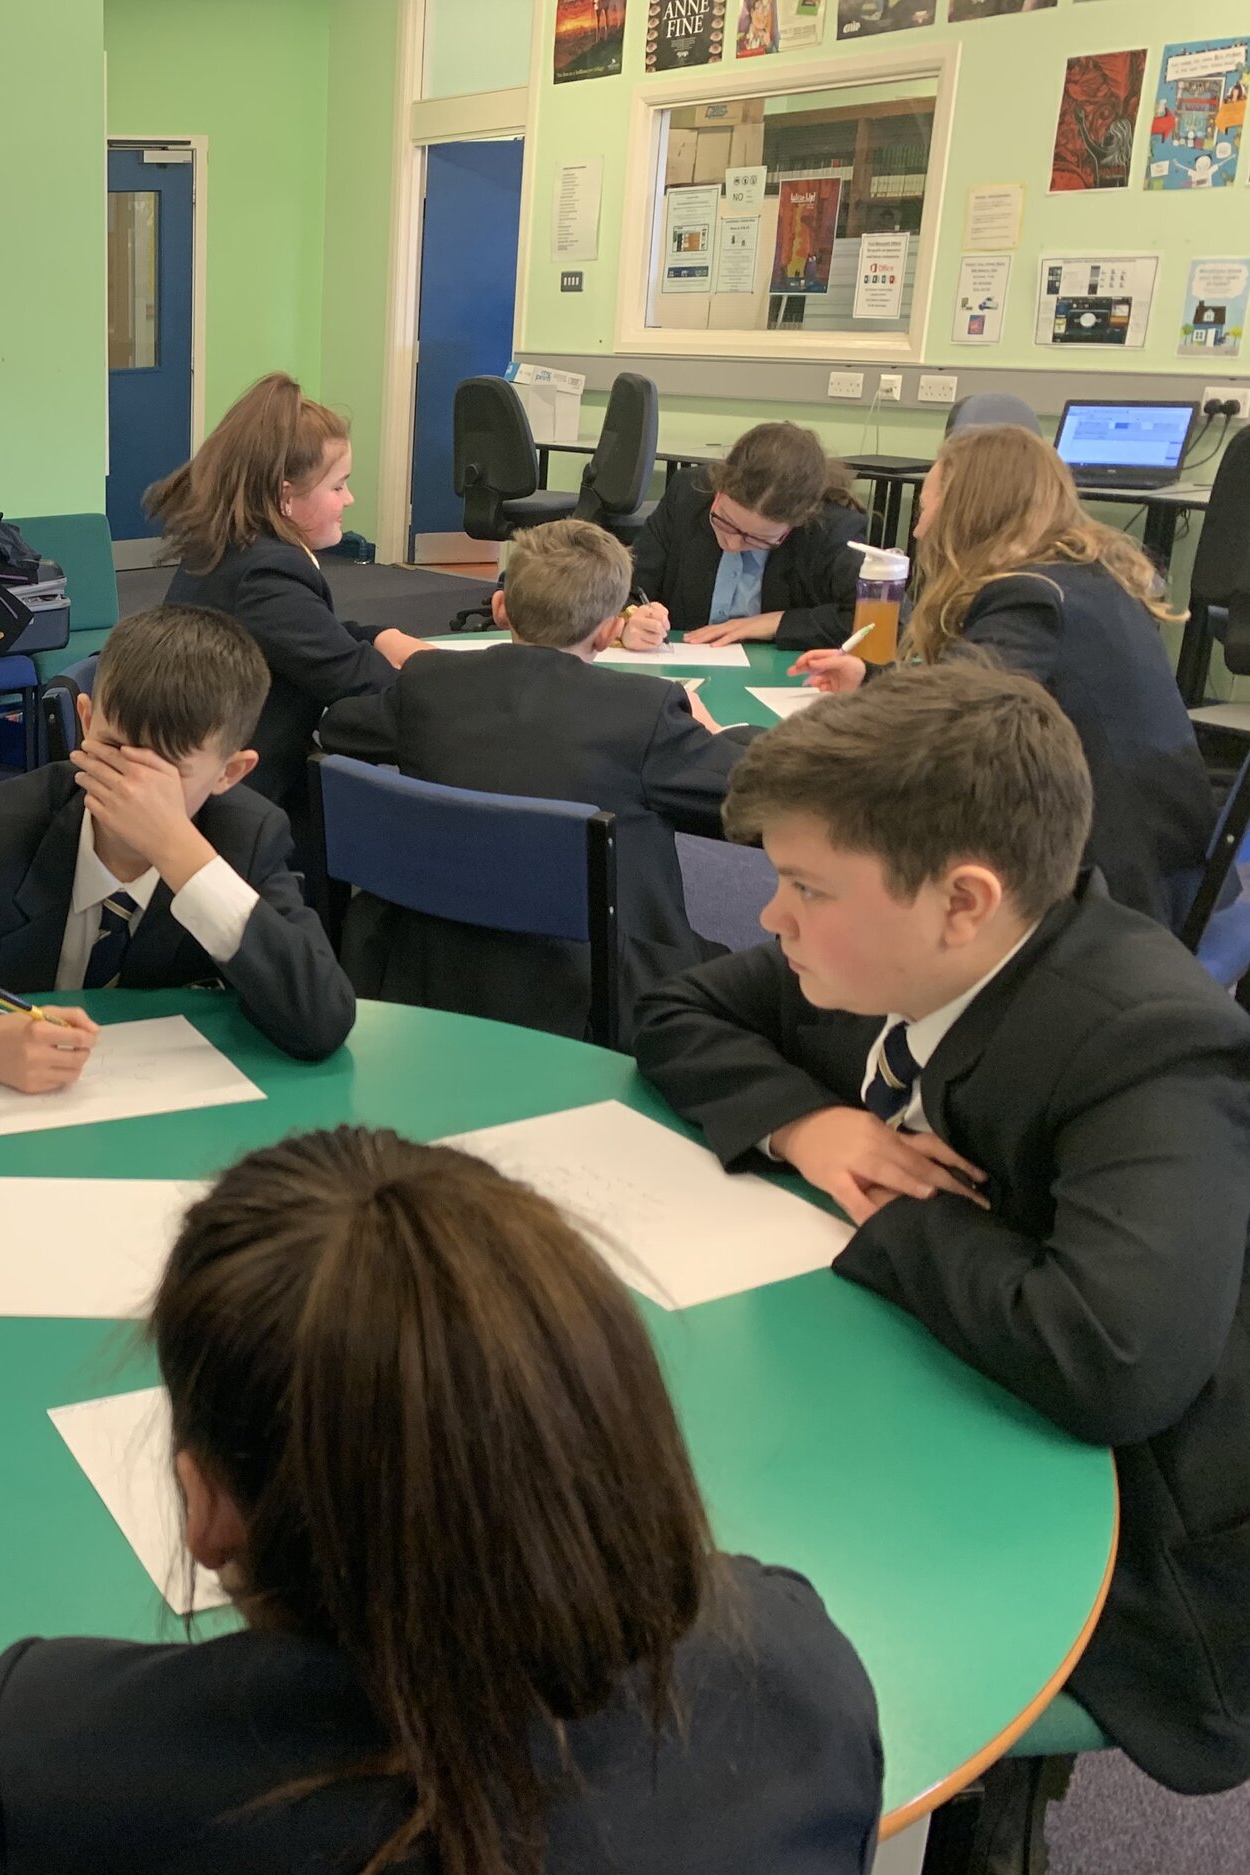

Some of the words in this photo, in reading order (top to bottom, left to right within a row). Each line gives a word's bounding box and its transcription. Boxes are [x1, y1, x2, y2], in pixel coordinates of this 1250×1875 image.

[662, 0, 710, 20] ANNE
[666, 15, 704, 38] FINE
[732, 193, 744, 201] NO
